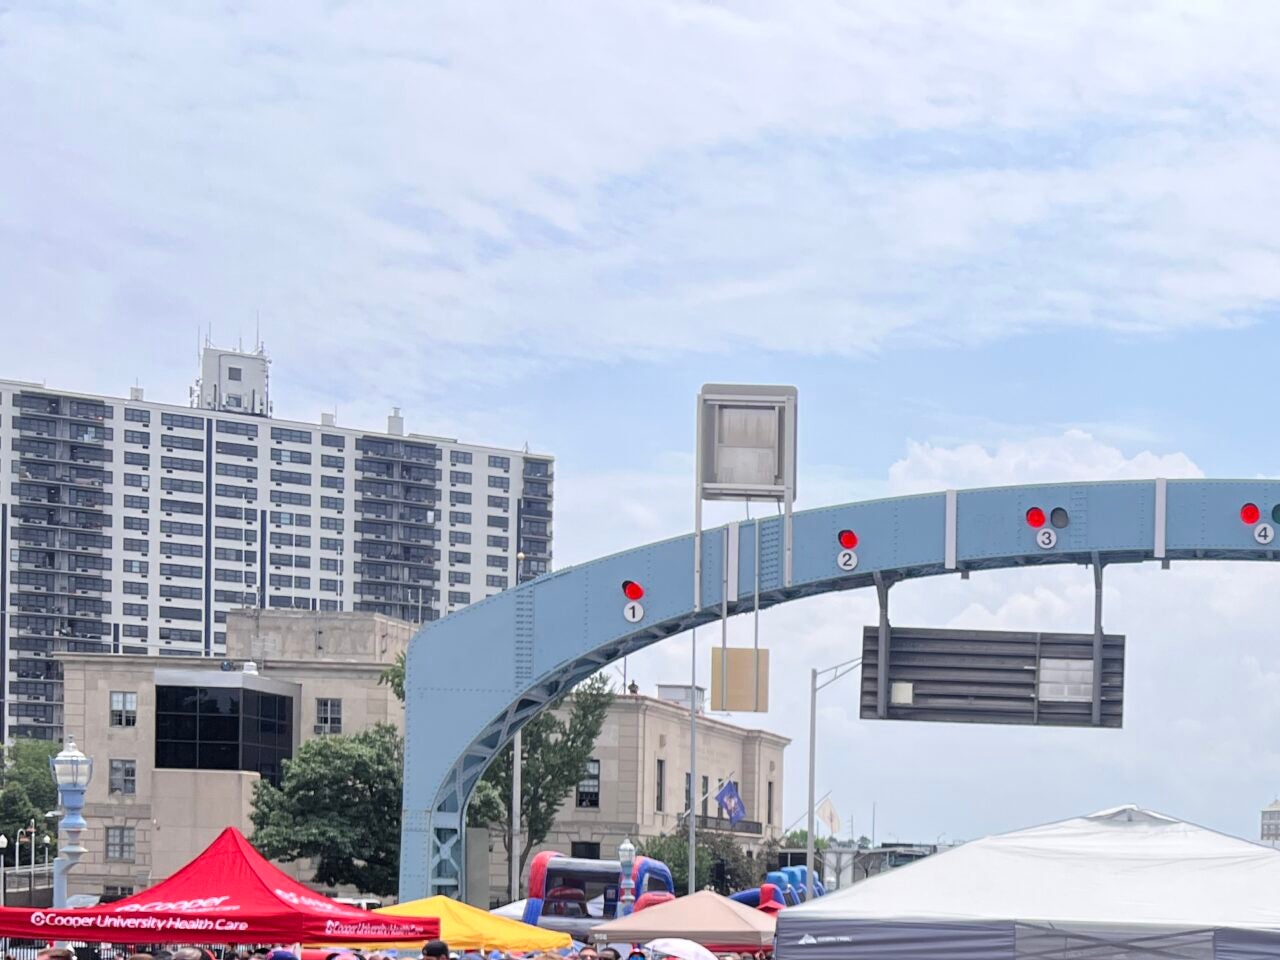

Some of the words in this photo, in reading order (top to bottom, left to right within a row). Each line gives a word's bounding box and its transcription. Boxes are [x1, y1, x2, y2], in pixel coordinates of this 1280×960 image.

[1041, 531, 1052, 546] 3
[1258, 527, 1269, 541] 4
[842, 552, 853, 567] 2
[628, 605, 636, 619] 1
[45, 914, 96, 929] Cooper
[96, 914, 168, 932] University
[166, 916, 214, 931] Health
[215, 918, 249, 931] Care
